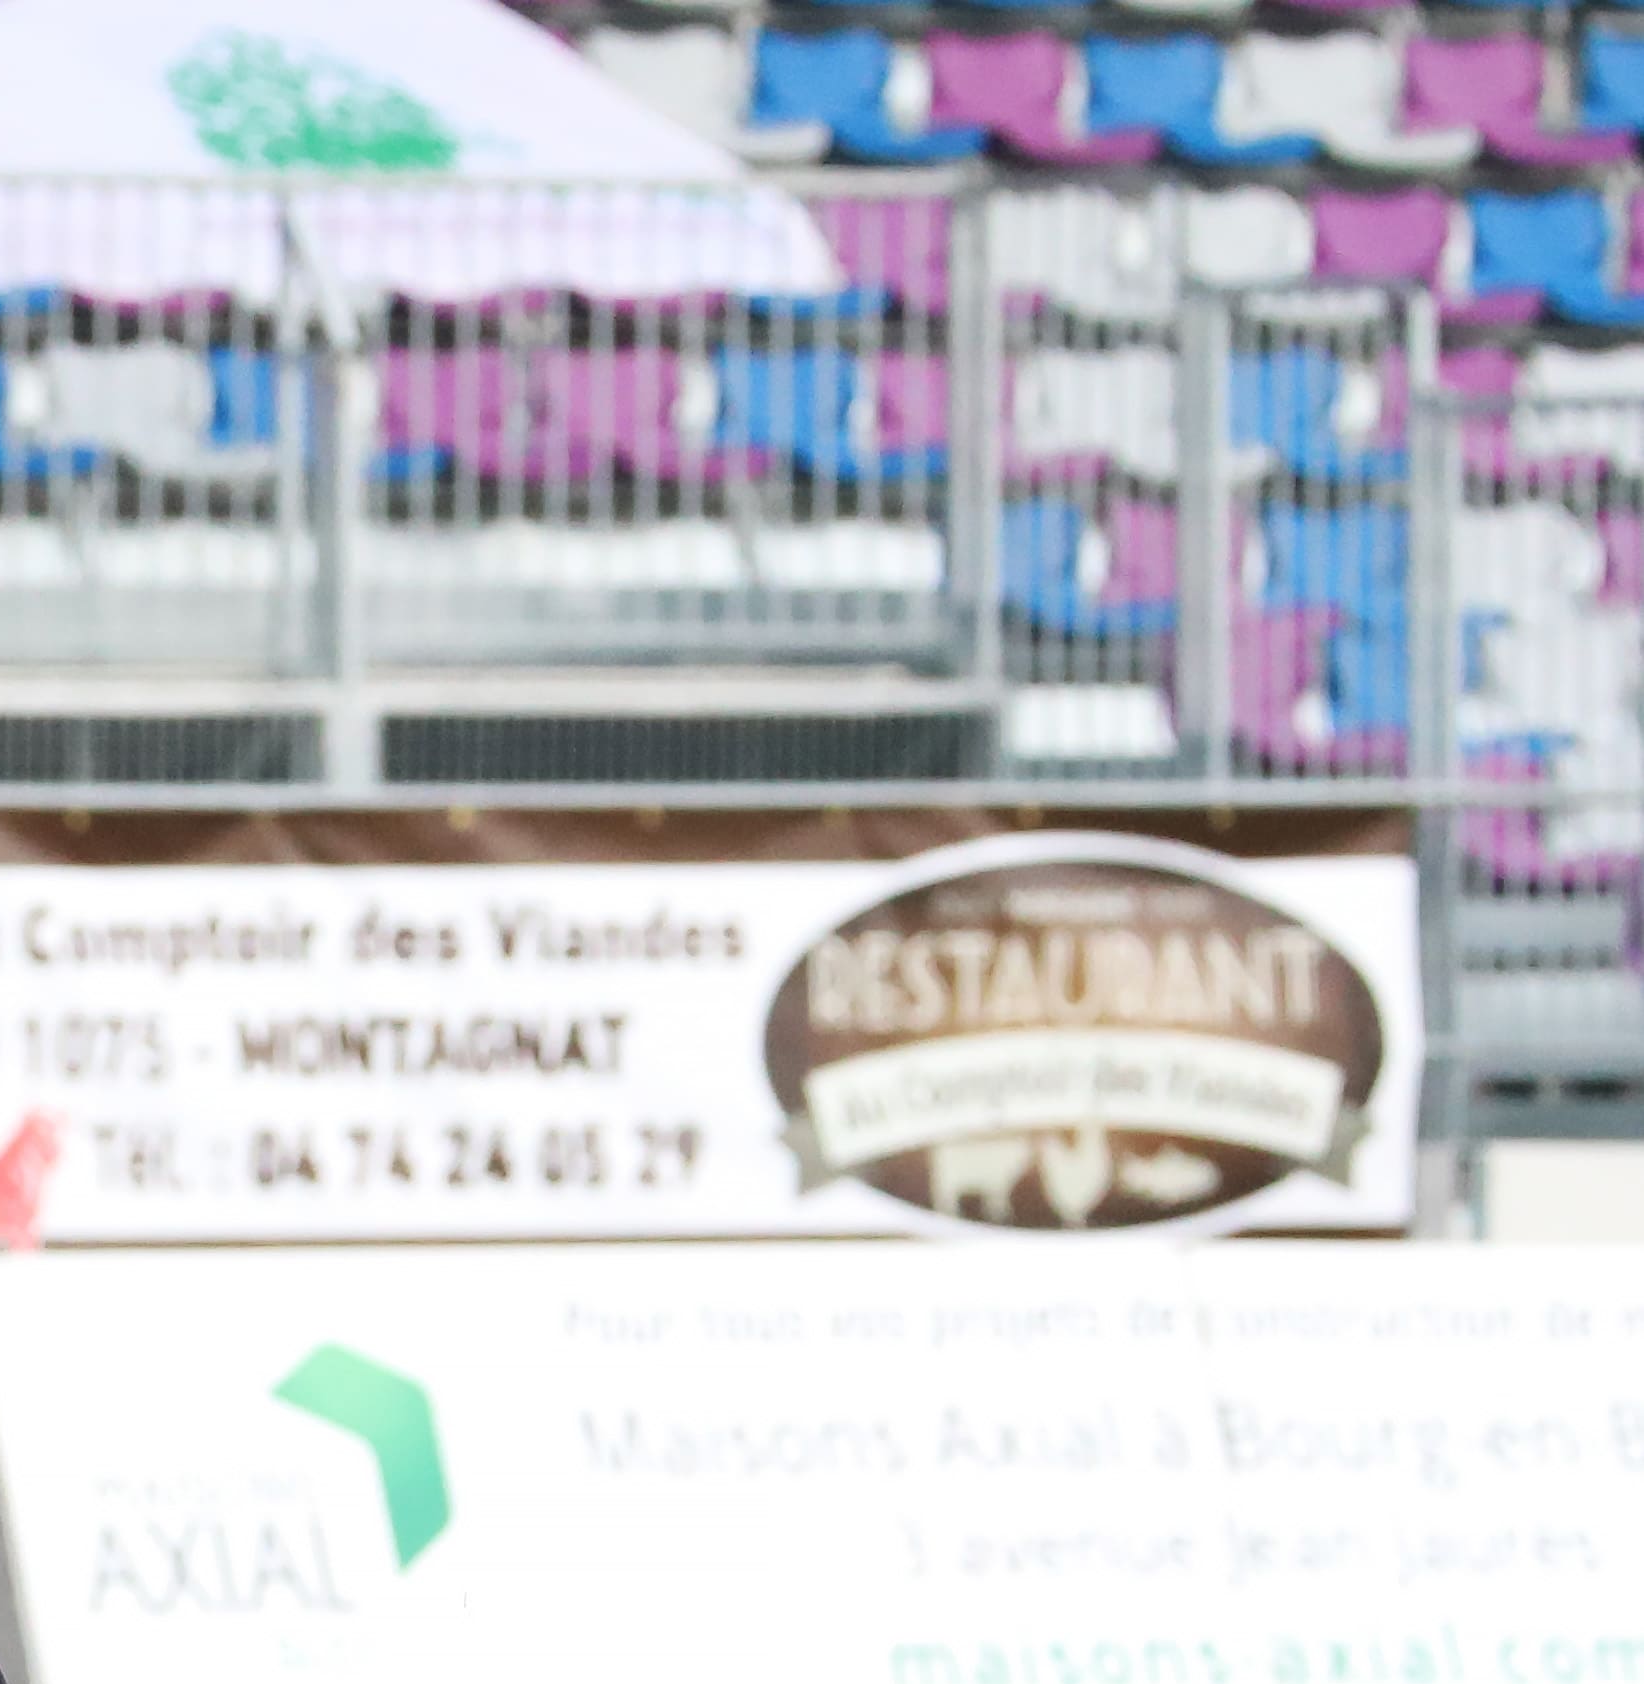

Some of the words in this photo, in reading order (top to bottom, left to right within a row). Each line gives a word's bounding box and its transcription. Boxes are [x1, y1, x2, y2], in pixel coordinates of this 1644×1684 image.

[22, 902, 314, 975] Comptoir
[350, 903, 460, 962] des
[487, 902, 743, 962] Viandes
[808, 926, 1323, 1033] RESTAURANT
[235, 1012, 629, 1077] MONTAGNAT
[252, 1124, 321, 1190] 04
[348, 1124, 415, 1190] 74
[443, 1124, 515, 1190] 24
[538, 1122, 609, 1190] 05
[635, 1122, 706, 1189] 29
[88, 1518, 358, 1616] AXIAL
